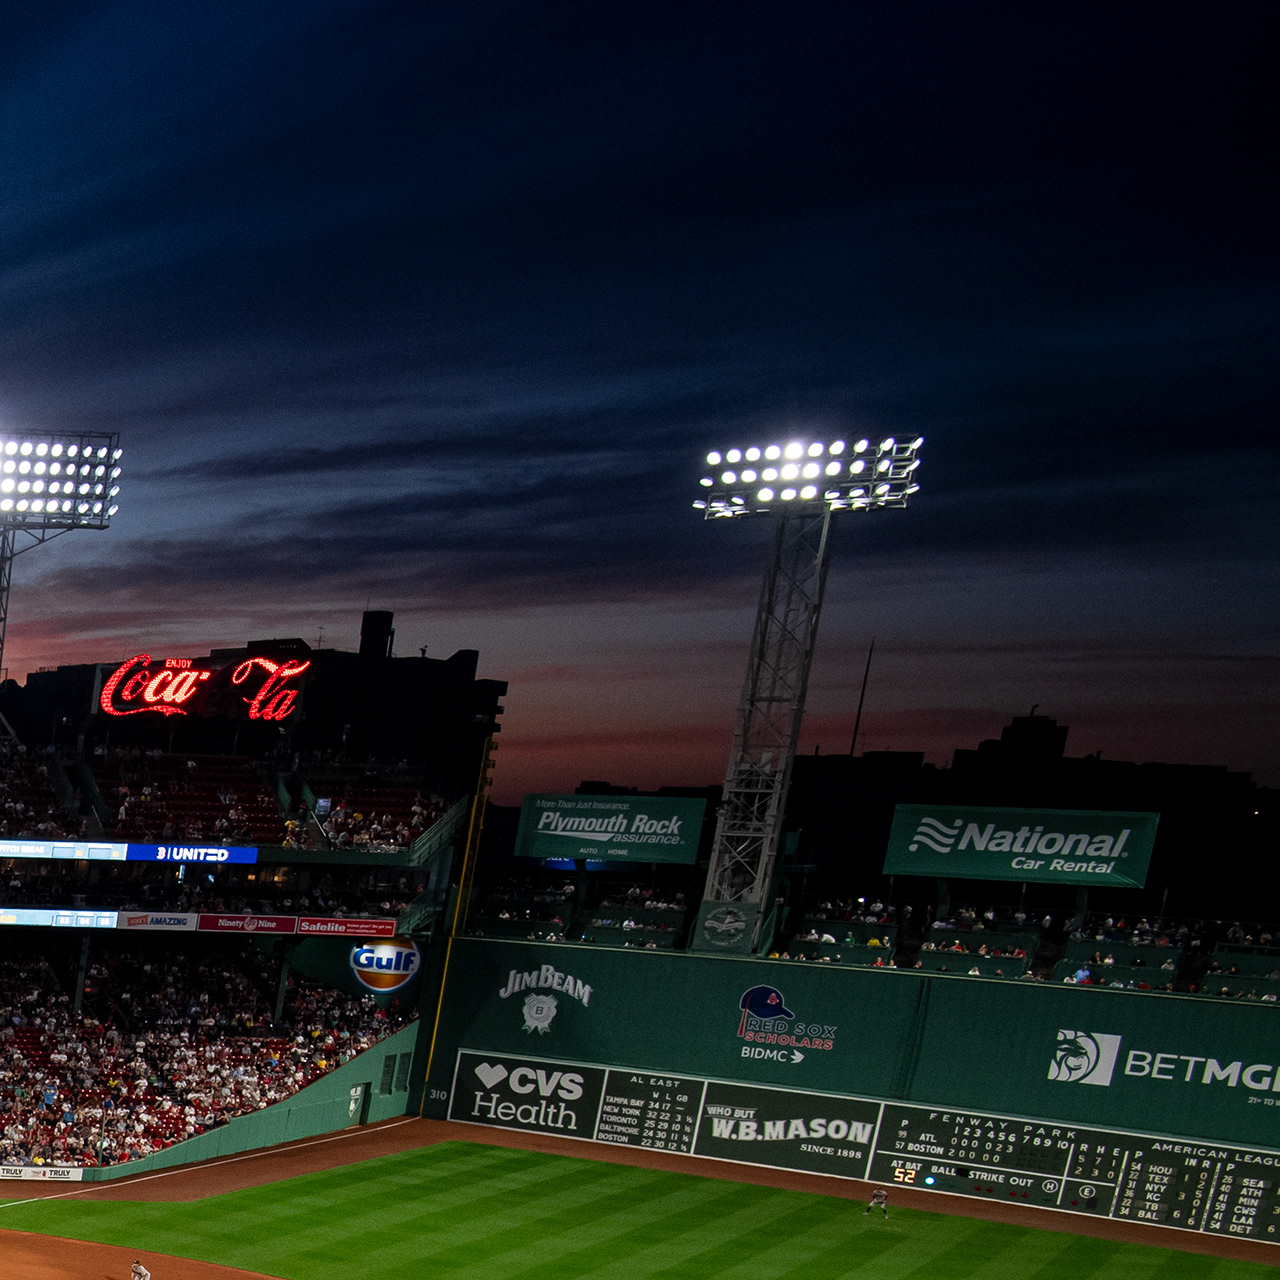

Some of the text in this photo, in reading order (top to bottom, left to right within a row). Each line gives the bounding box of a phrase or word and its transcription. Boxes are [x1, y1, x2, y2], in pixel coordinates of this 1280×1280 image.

[165, 658, 192, 669] ENJOY
[535, 800, 630, 810] More Than Just Insurance.
[537, 811, 683, 835] Plymouth Rock
[612, 833, 680, 845] assurance
[957, 822, 1130, 858] National
[172, 847, 229, 862] UNITED
[579, 847, 628, 856] AUTO HOME
[1010, 856, 1115, 874] Car Rental
[149, 916, 187, 926] AMAZING
[218, 918, 276, 928] Ninety Nine
[300, 920, 345, 933] Safelite
[353, 948, 416, 971] Gulf
[499, 964, 591, 1007] JIM BEAM
[534, 1006, 544, 1015] B
[746, 1017, 837, 1039] RED SOX
[743, 1031, 834, 1051] SCHOLARS
[740, 1045, 788, 1062] BIDMC
[1124, 1049, 1280, 1093] BETMG
[508, 1066, 584, 1101] CVS
[630, 1076, 681, 1088] AL EAST
[429, 1089, 448, 1100] 310
[676, 1094, 689, 1103] GB
[605, 1095, 628, 1105] TAMPA
[630, 1098, 645, 1108] BAY
[648, 1101, 660, 1110] 34
[471, 1091, 577, 1130] Health
[602, 1105, 671, 1121] NEW YORK 32 22
[706, 1106, 755, 1119] WHO BUT
[601, 1114, 681, 1131] TORONTO 25 29 10
[901, 1119, 909, 1127] P
[929, 1111, 1077, 1140] FENWAY PARK
[599, 1123, 640, 1136] BALTIMORE
[643, 1129, 654, 1137] 24
[656, 1131, 667, 1139] 30
[897, 1130, 937, 1143] 99 ATL
[597, 1132, 677, 1150] BOSTON 22 30 12
[799, 1143, 863, 1160] SINCE 1898
[894, 1141, 945, 1155] 57 BOSTON
[1151, 1142, 1228, 1160] AMERICAN
[890, 1159, 923, 1171] AT BAT
[1148, 1165, 1173, 1175] HOU
[893, 1168, 917, 1184] 52
[930, 1165, 1034, 1188] BALL STRIKE OUT
[1147, 1175, 1170, 1184] TEX
[1144, 1183, 1168, 1193] NYY
[1241, 1178, 1265, 1189] SEA
[1145, 1193, 1162, 1202] KC
[1239, 1188, 1263, 1198] ATH
[1144, 1202, 1159, 1211] TB
[1238, 1197, 1259, 1207] MIN
[1137, 1210, 1159, 1221] BAL
[1234, 1206, 1257, 1216] CWS
[1232, 1215, 1254, 1226] LAA
[1229, 1224, 1253, 1235] DET
